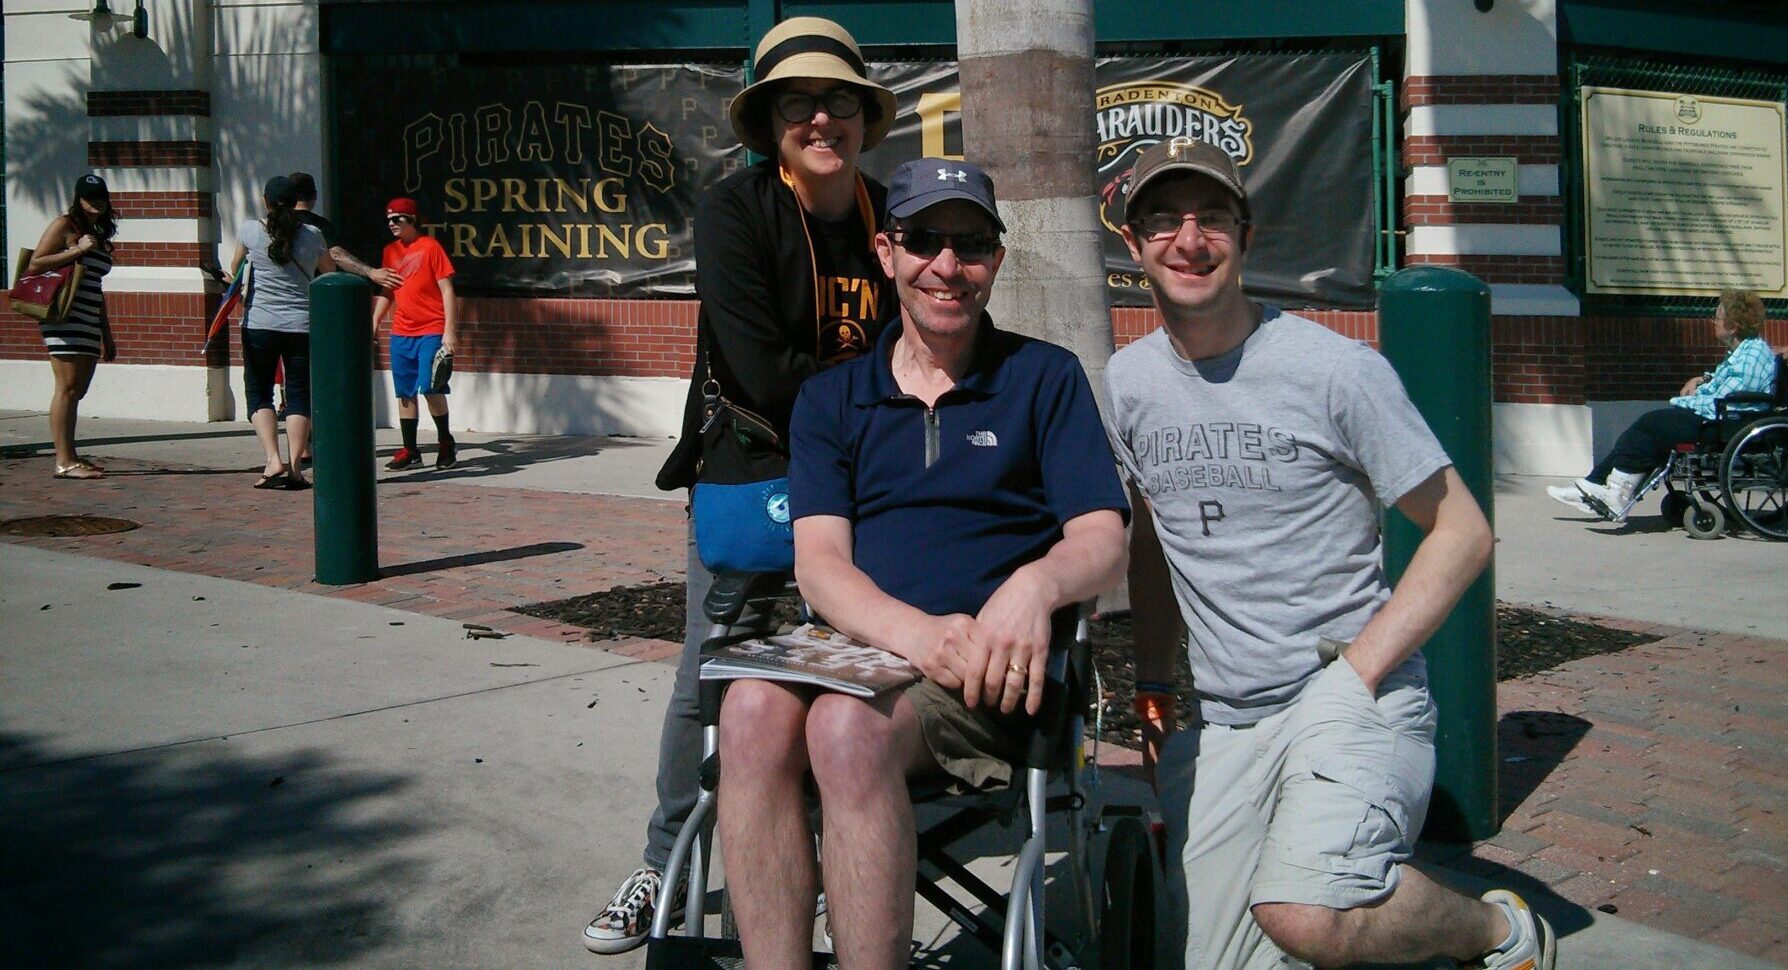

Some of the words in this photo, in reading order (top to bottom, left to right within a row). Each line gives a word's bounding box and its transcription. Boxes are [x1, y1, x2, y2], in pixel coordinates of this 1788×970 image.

[682, 97, 697, 121] P
[1100, 89, 1213, 111] RADENTON
[702, 126, 718, 149] P
[1638, 123, 1668, 135] RULES
[1677, 127, 1738, 140] REGULATIONS
[402, 100, 676, 194] PIRATES
[1458, 168, 1506, 177] RE-ENTRY
[443, 177, 628, 214] SPRING
[1453, 187, 1513, 196] PROHIBITED
[421, 222, 670, 259] TRAINING
[1133, 422, 1299, 470] PIRATES
[1150, 463, 1282, 496] BASEBALL
[1198, 500, 1226, 537] P
